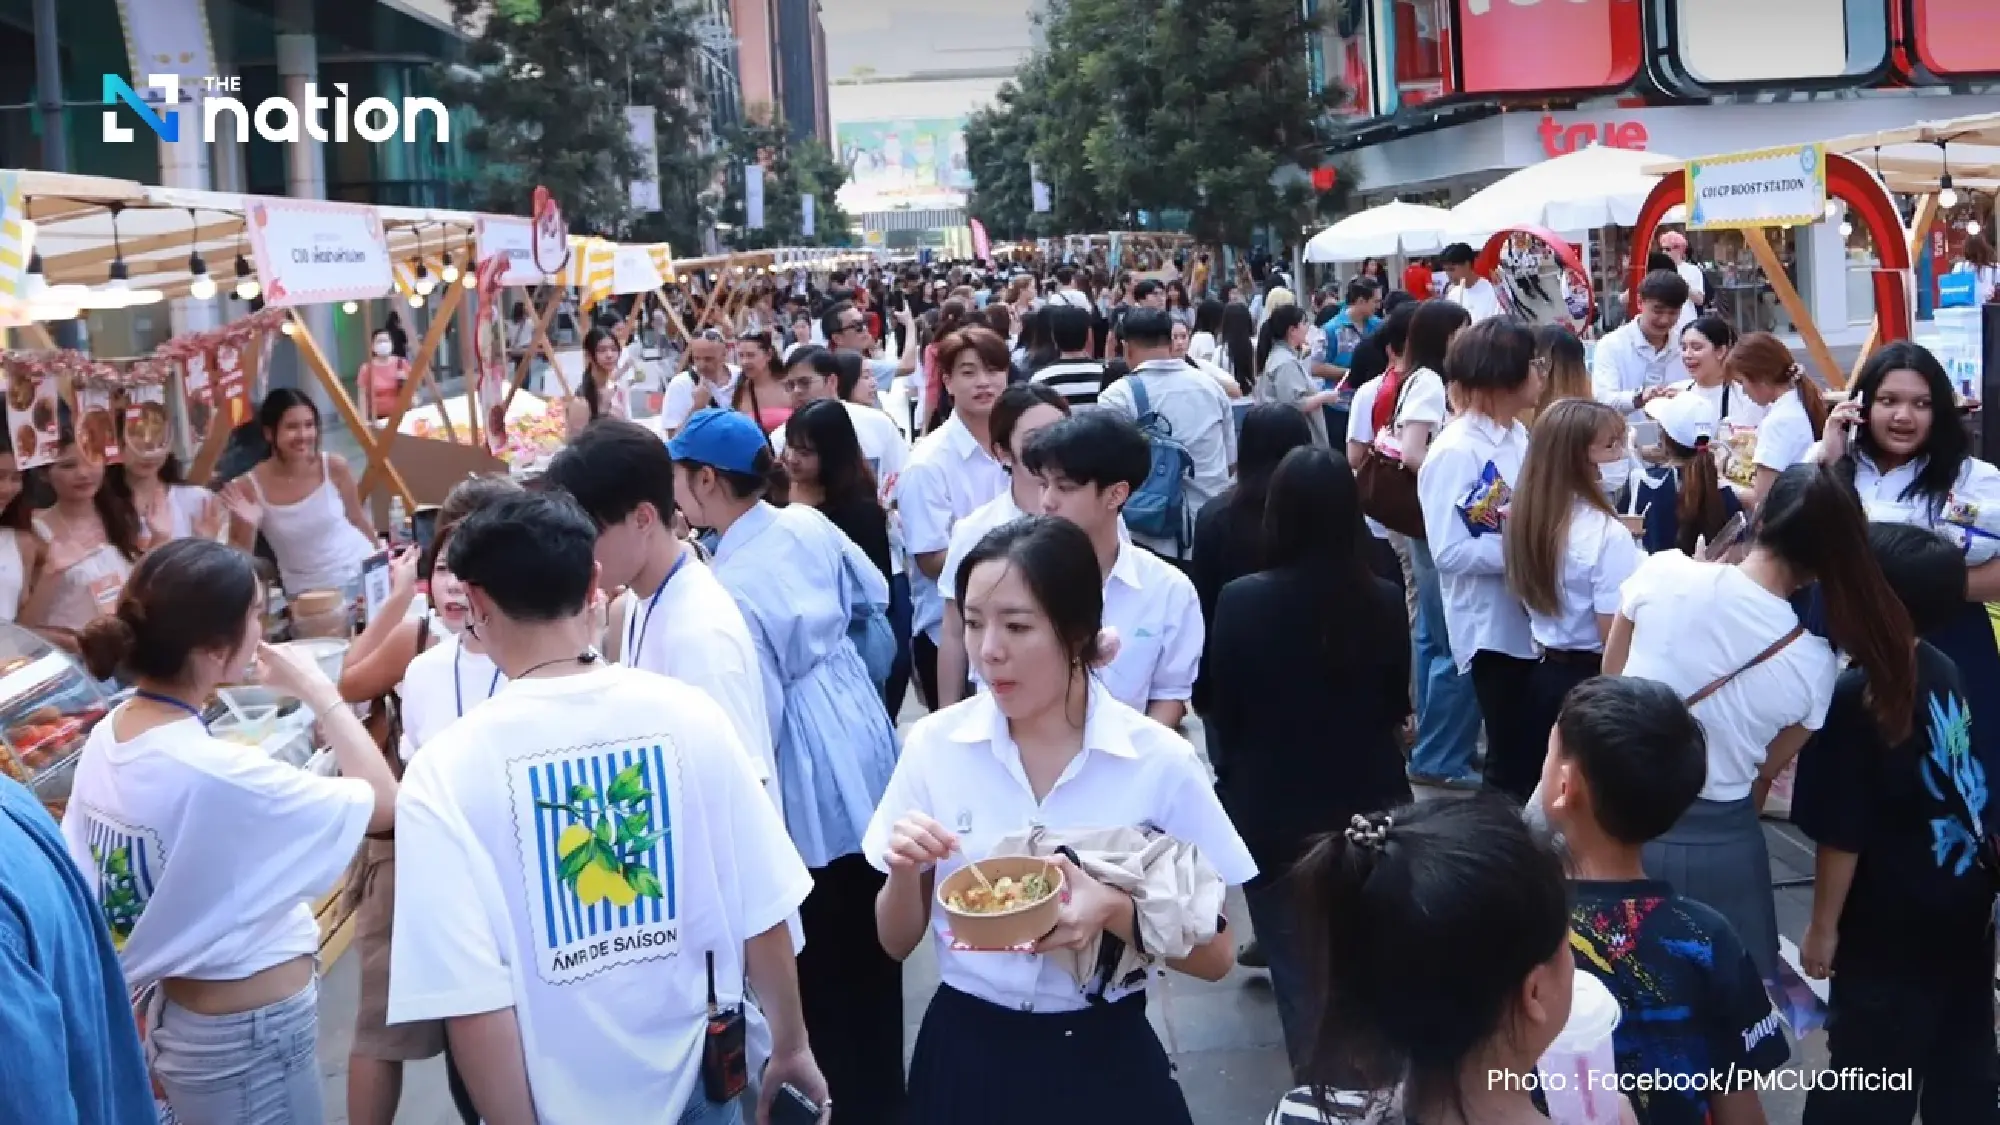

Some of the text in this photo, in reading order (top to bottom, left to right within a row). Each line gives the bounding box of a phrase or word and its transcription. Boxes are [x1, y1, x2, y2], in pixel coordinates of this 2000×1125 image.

[1537, 115, 1649, 160] true
[1731, 181, 1763, 196] BOOST
[1763, 178, 1804, 193] STATION
[588, 940, 609, 961] DE
